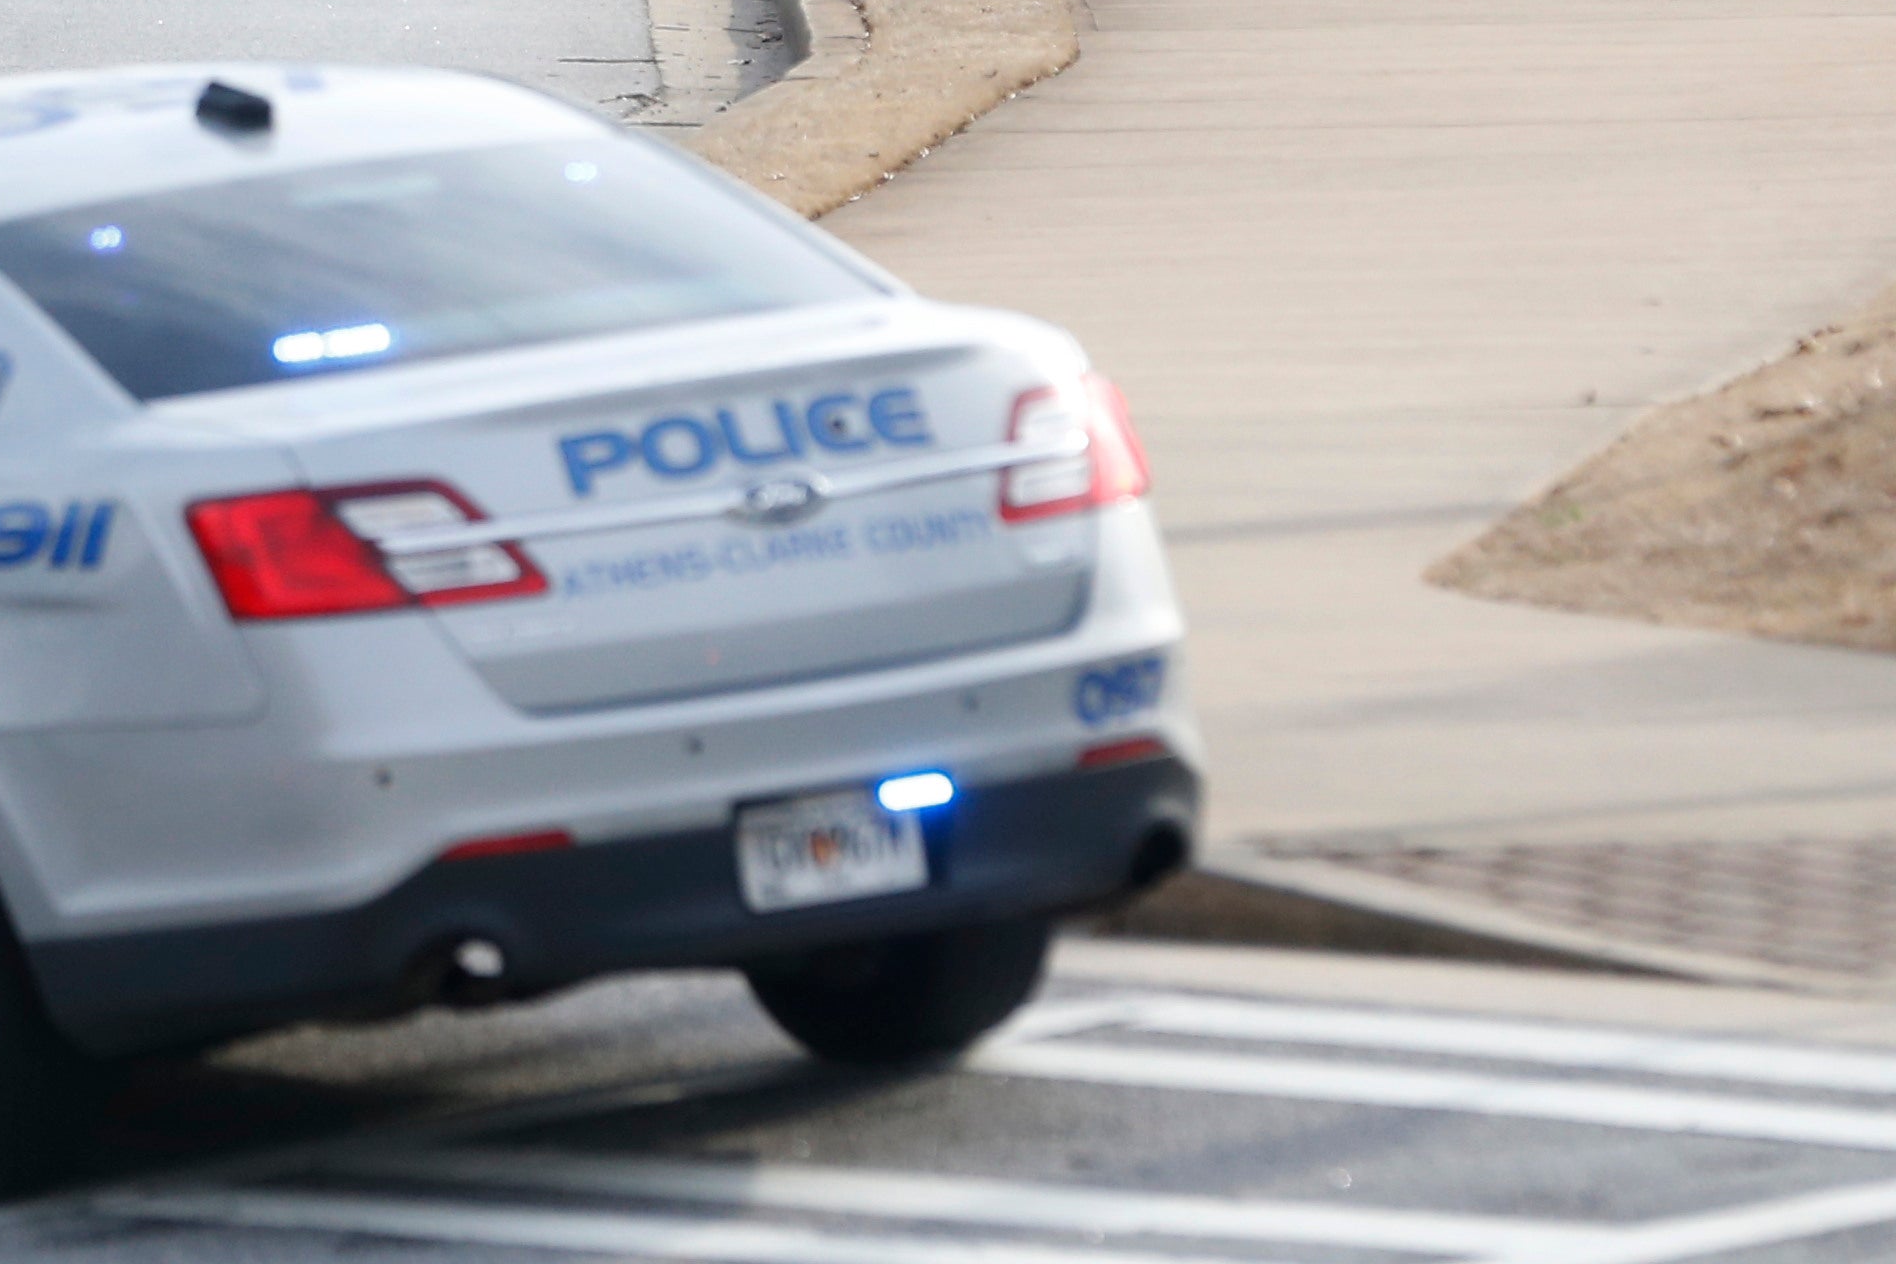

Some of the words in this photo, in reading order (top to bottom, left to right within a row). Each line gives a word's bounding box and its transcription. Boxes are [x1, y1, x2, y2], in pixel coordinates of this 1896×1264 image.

[557, 387, 933, 499] POLICE
[562, 523, 852, 598] ATHENS-CLARKE
[865, 510, 992, 554] COUNTY
